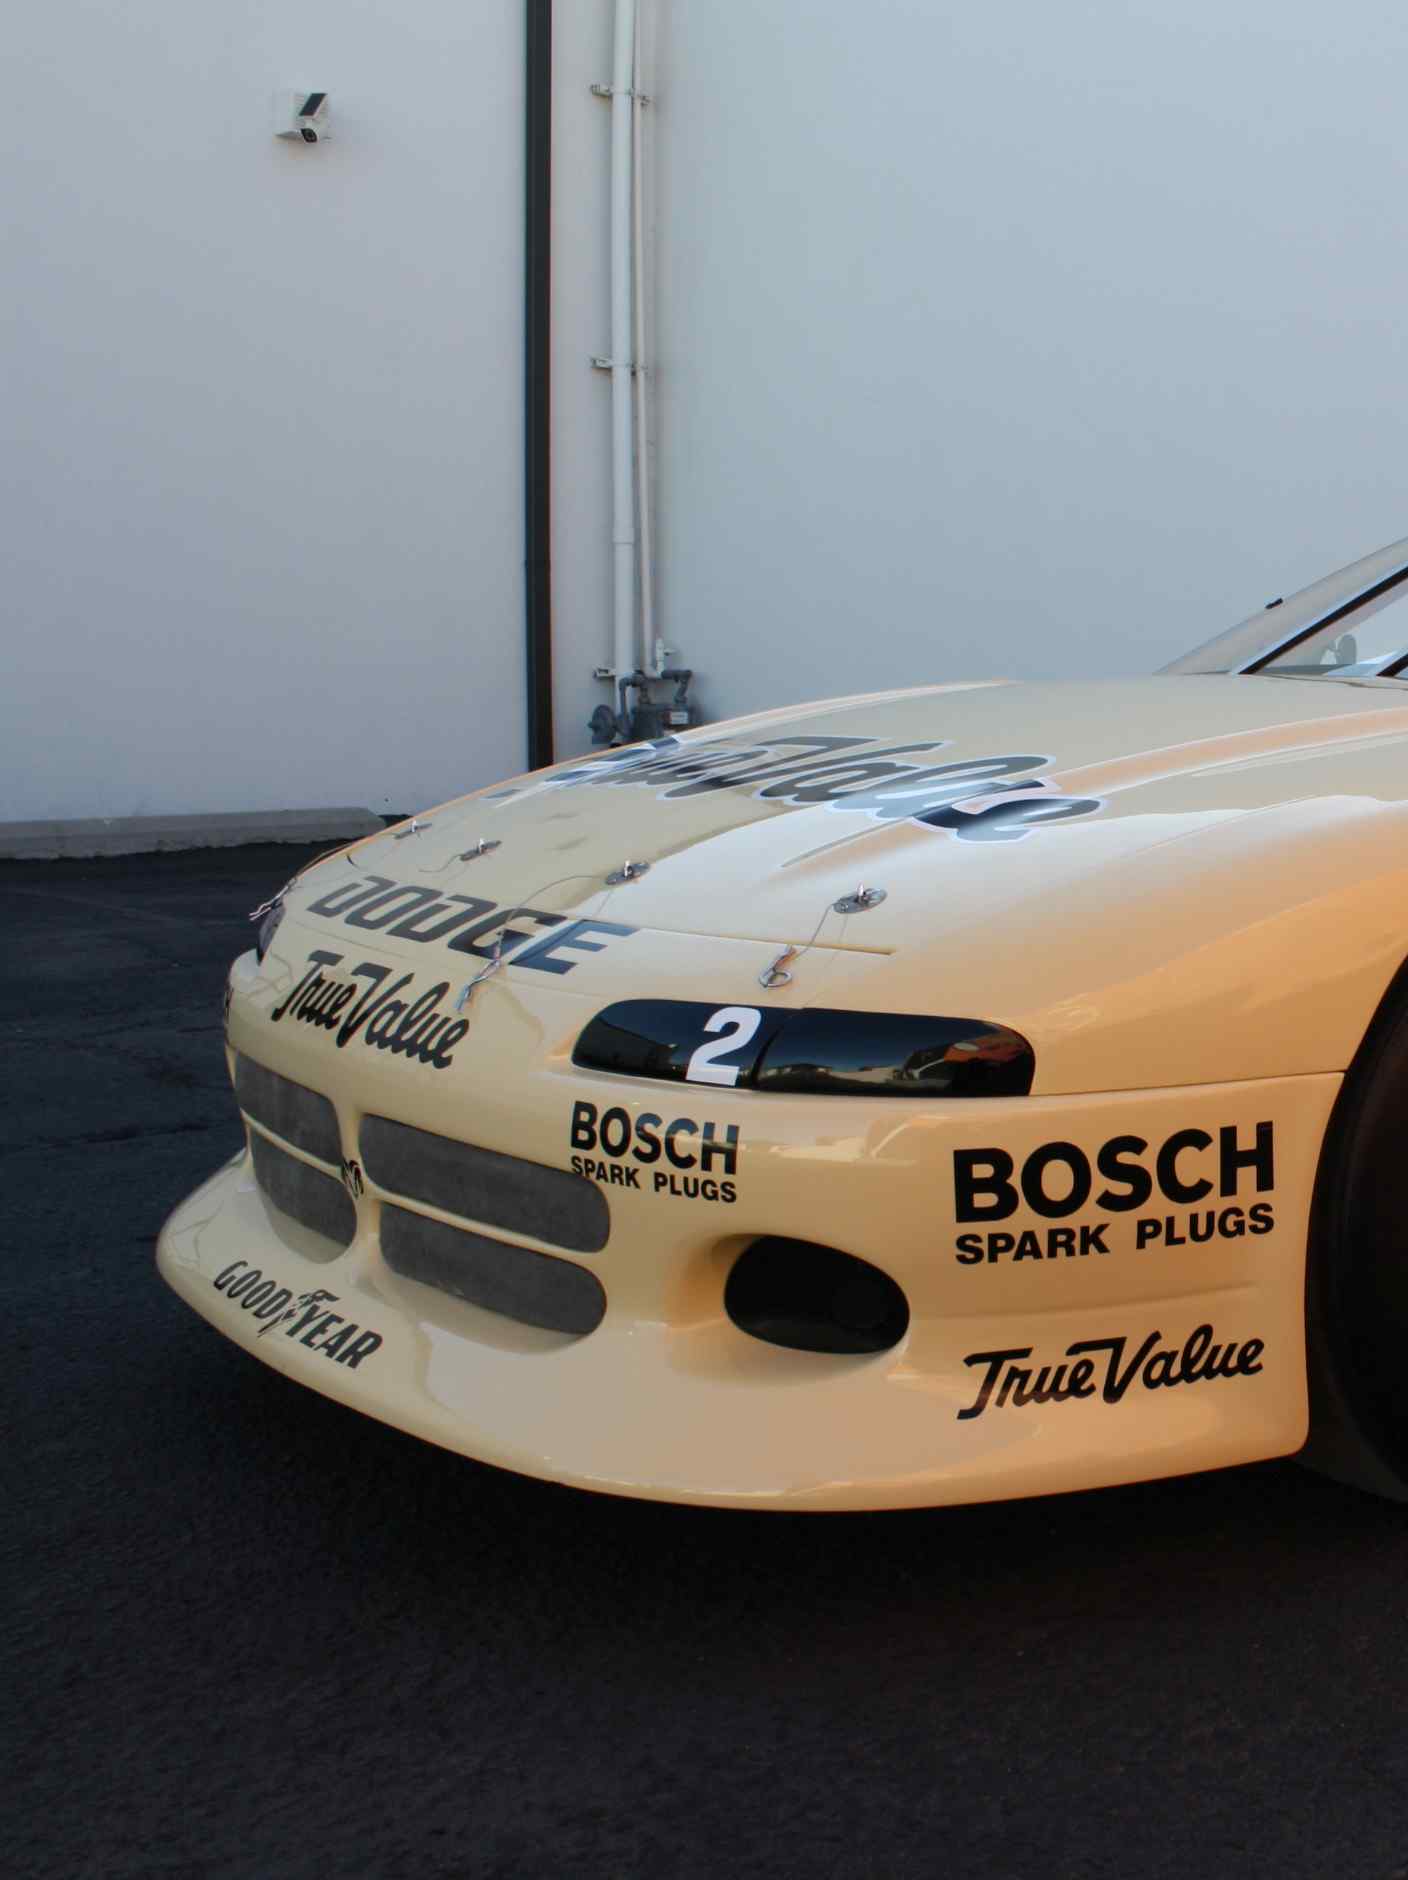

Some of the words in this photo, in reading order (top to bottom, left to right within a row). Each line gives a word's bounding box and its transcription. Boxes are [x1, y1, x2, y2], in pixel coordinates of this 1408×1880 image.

[306, 874, 640, 975] DODGE
[270, 949, 357, 1030] True
[335, 961, 470, 1070] Value
[685, 1006, 762, 1087] 2
[570, 1100, 740, 1175] BOSCH
[570, 1155, 641, 1189] SPARK
[653, 1172, 738, 1203] PLUGS
[953, 1120, 1274, 1223] BOSCH
[955, 1223, 1111, 1265] SPARK
[1136, 1203, 1275, 1250] PLUGS
[213, 1260, 384, 1369] GOODYEAR
[957, 1347, 1097, 1420] True
[1066, 1323, 1265, 1404] Value
